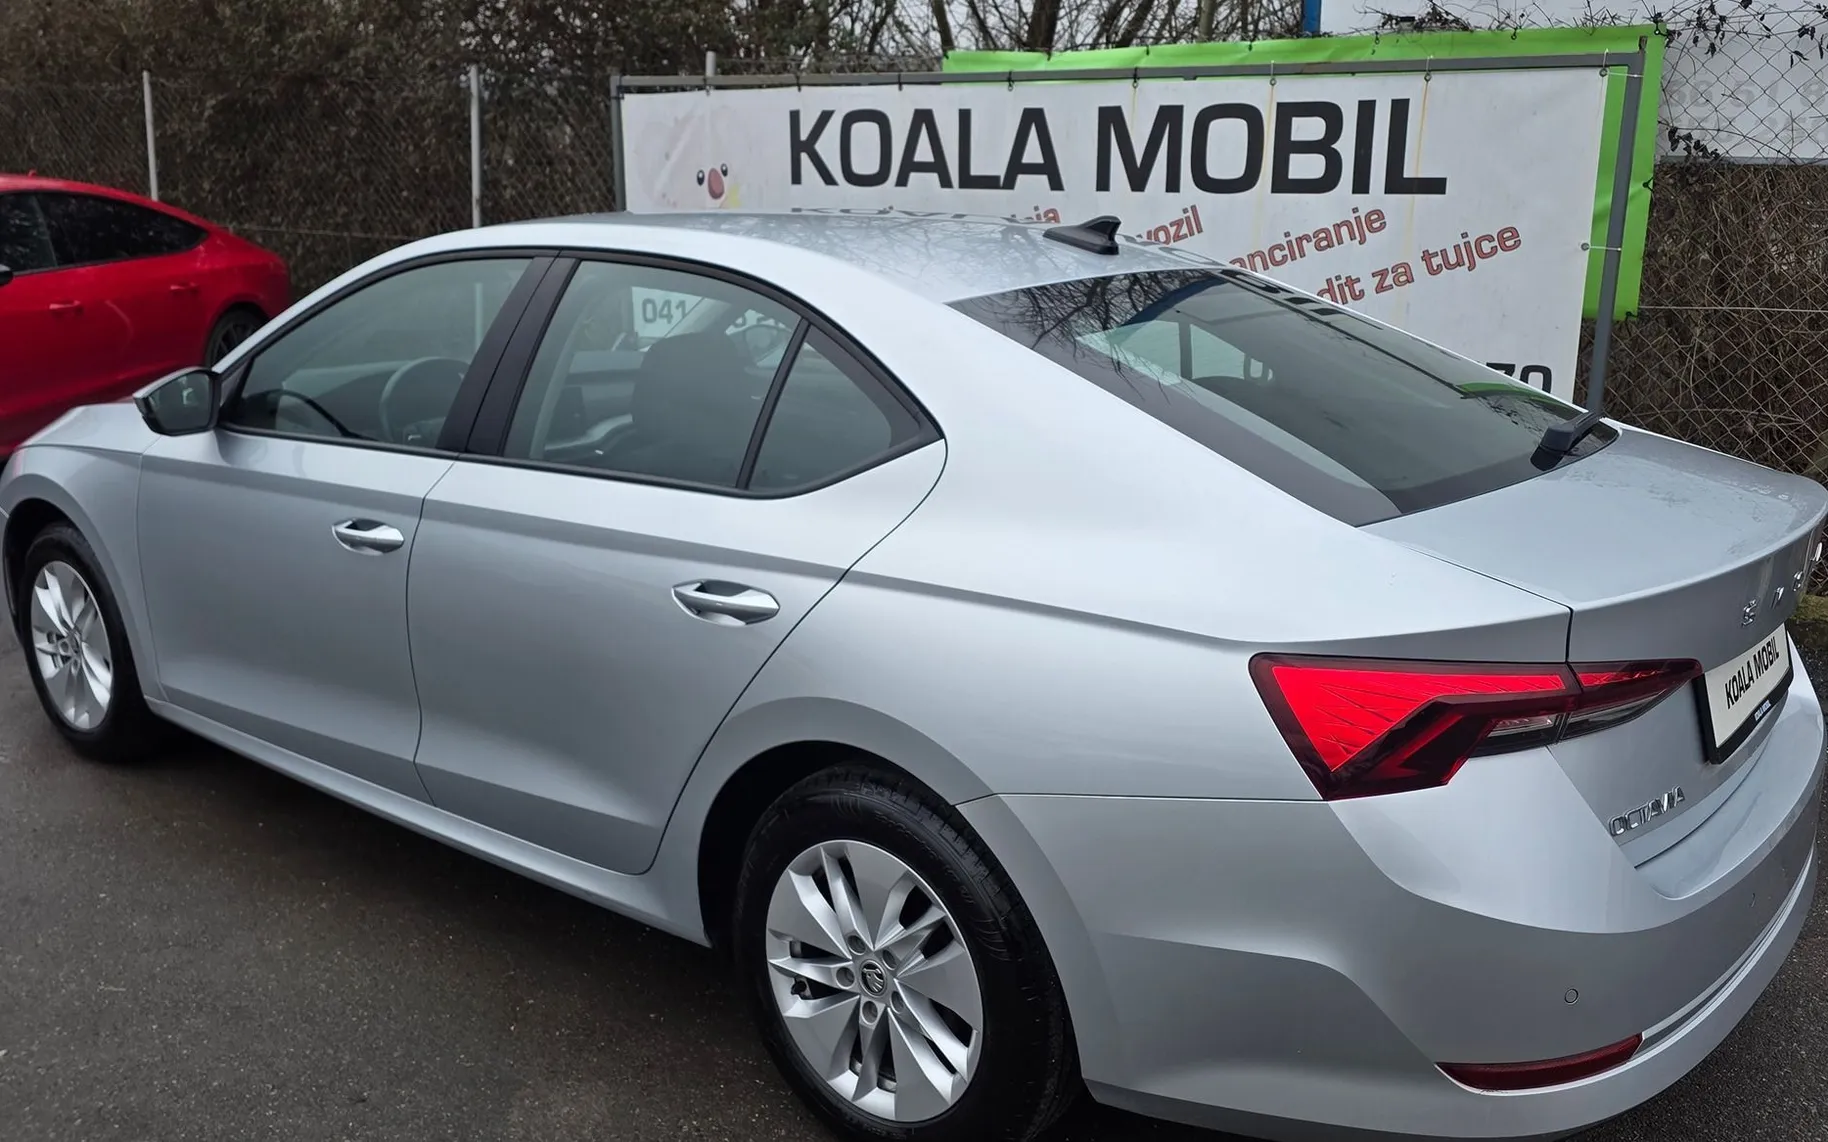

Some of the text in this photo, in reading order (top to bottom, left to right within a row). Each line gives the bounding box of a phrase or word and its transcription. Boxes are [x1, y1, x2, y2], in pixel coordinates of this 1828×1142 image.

[789, 98, 1447, 195] KOALA MOBIL
[1371, 261, 1415, 294] za
[1421, 226, 1522, 276] tujce
[1724, 660, 1755, 710] KOALA
[1752, 636, 1780, 680] MOBIL
[1608, 784, 1686, 837] OCTAVIA
